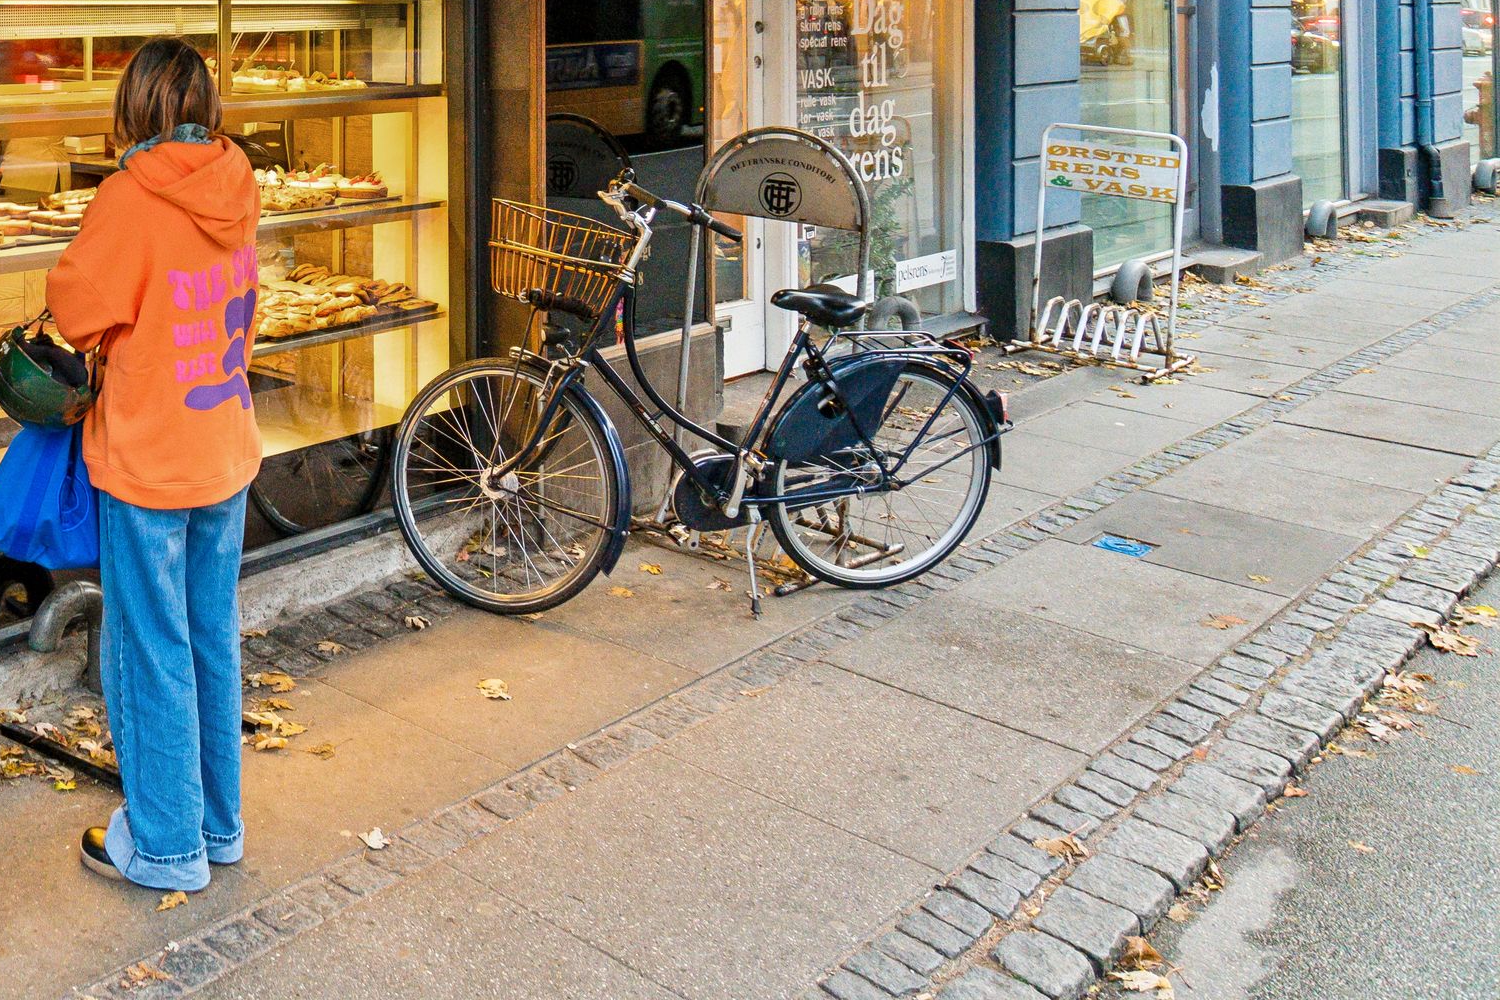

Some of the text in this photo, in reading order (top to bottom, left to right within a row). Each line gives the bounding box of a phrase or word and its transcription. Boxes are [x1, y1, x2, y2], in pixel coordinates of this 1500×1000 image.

[862, 42, 889, 89] til
[849, 90, 898, 147] dag
[788, 159, 837, 184] CONDITORI
[849, 145, 904, 183] rens
[1047, 145, 1181, 169] ØRSTED
[1047, 159, 1141, 180] RENS
[1051, 175, 1176, 200] & VASK
[167, 263, 227, 311] THE
[172, 319, 217, 347] WILL
[175, 351, 217, 383] RISE
